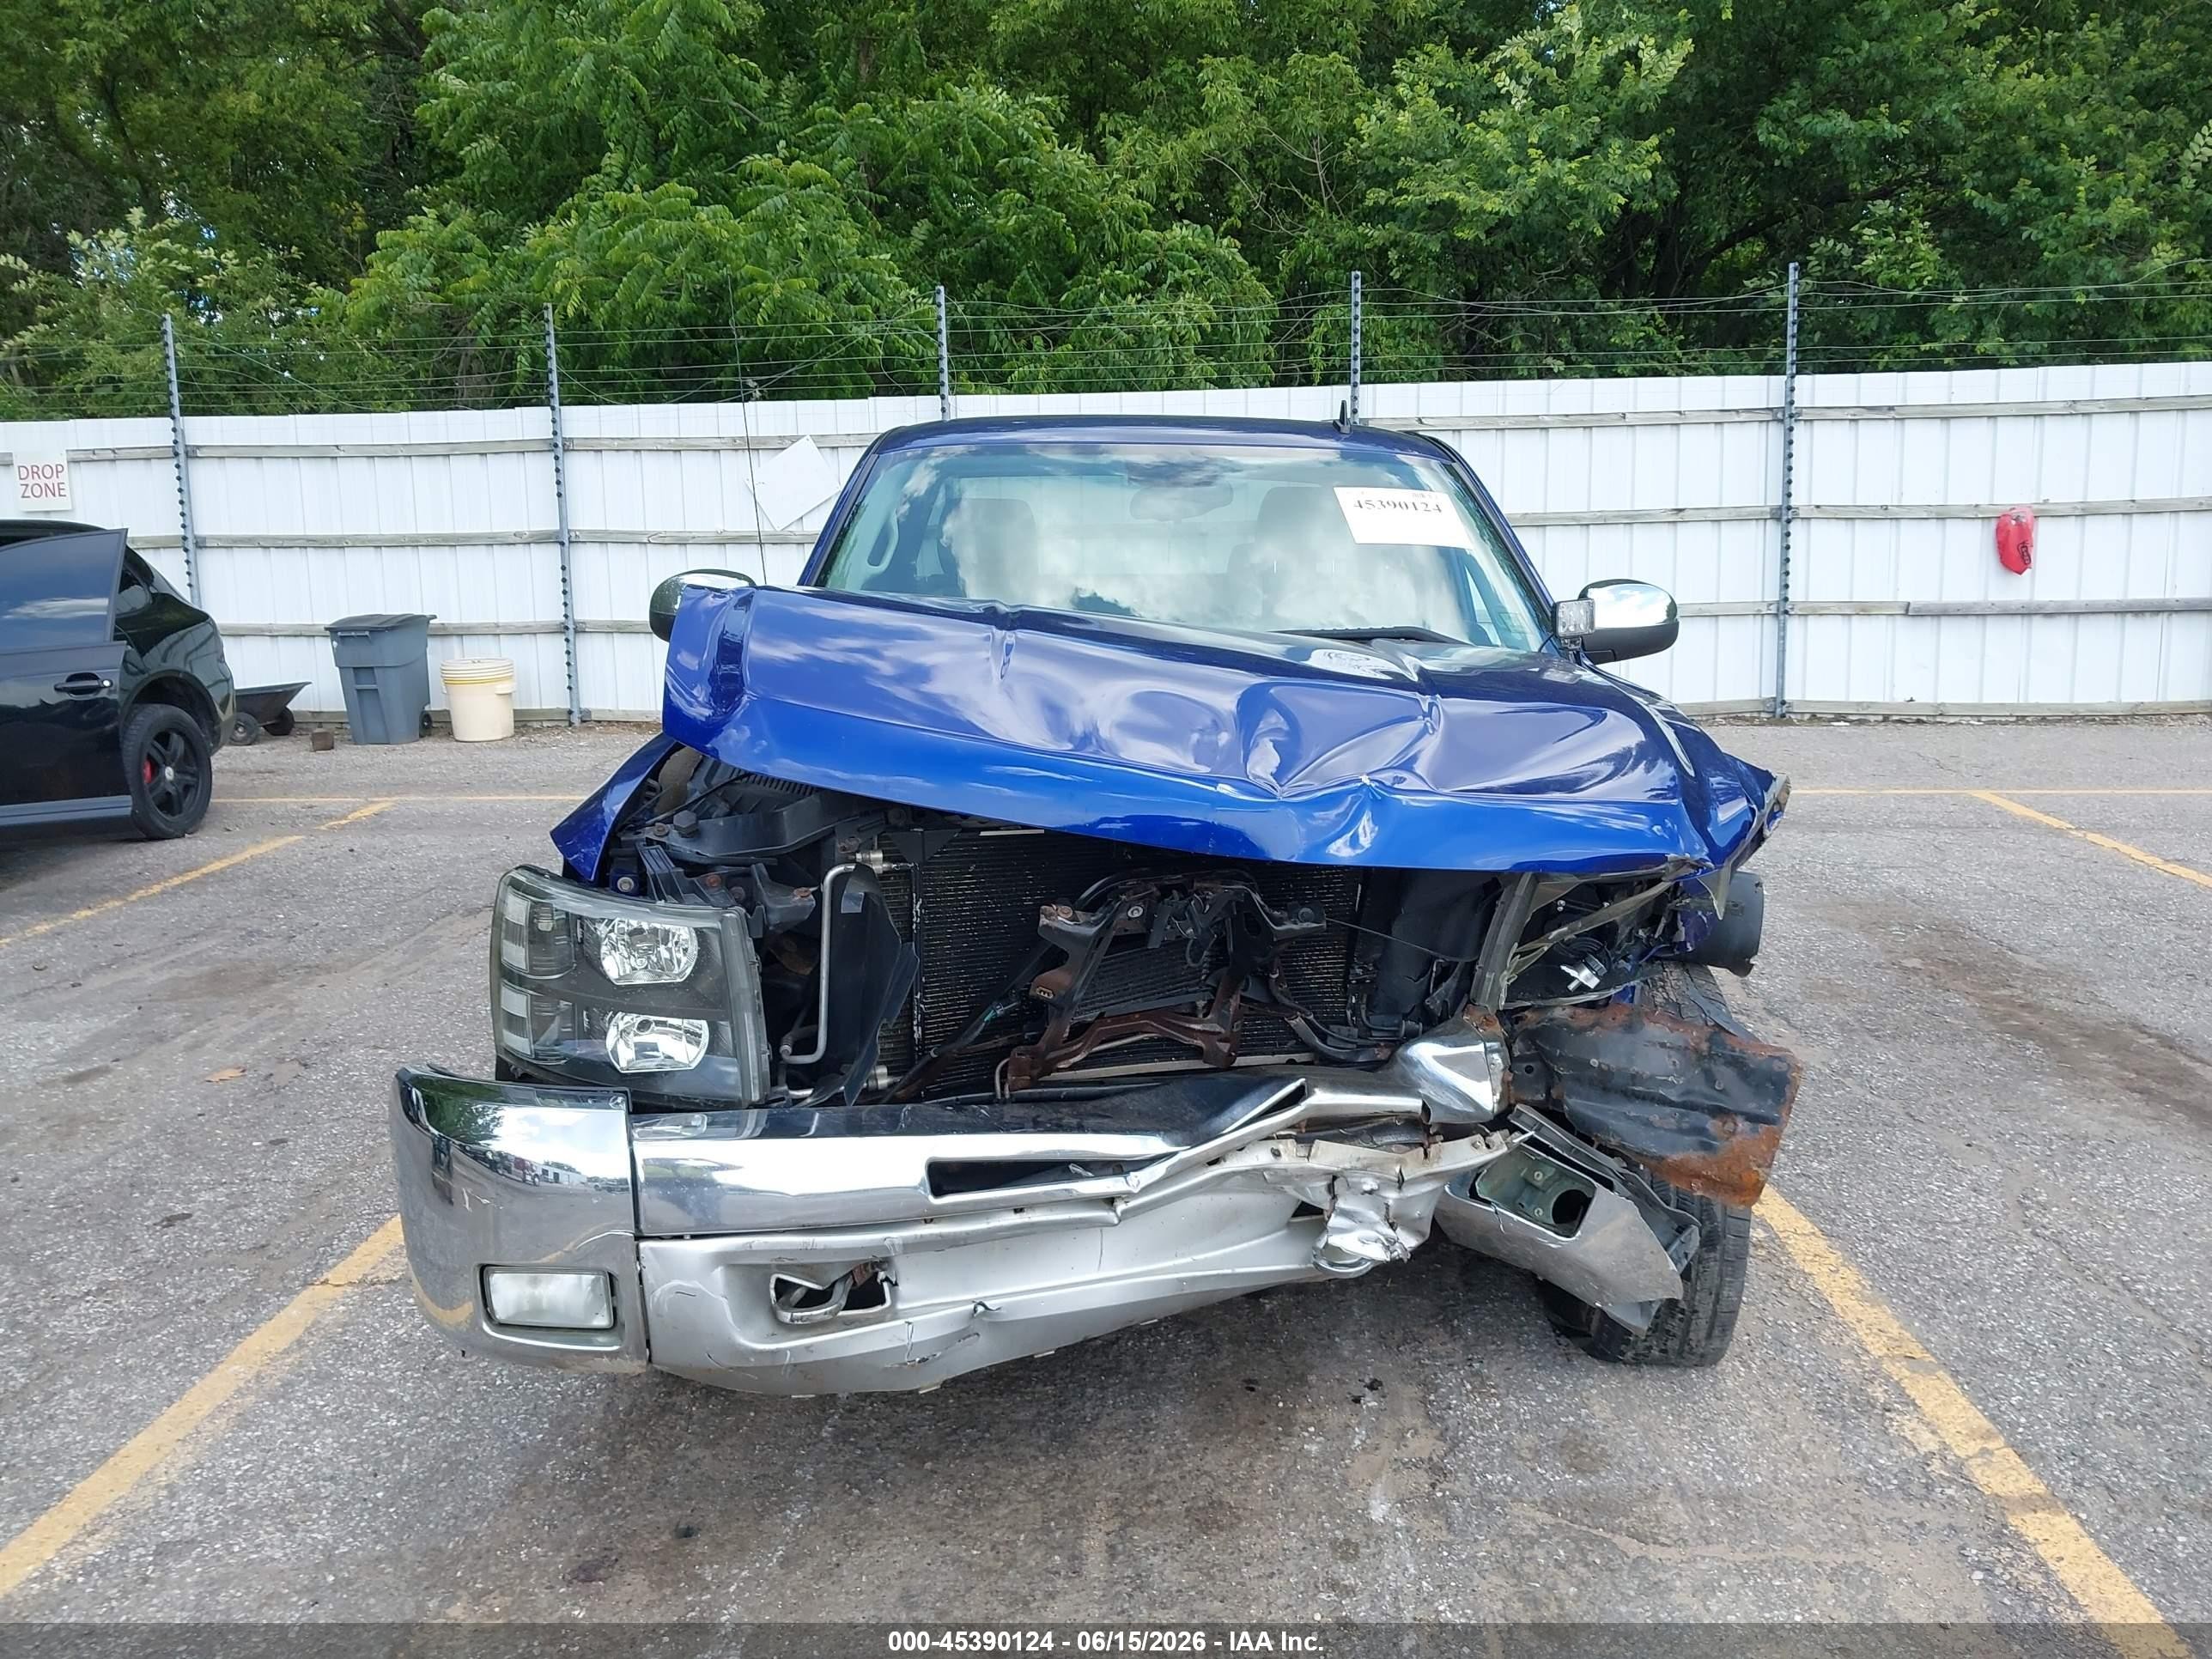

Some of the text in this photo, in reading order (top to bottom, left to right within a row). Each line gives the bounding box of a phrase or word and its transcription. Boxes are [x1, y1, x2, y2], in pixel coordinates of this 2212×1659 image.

[17, 464, 65, 481] DROP
[20, 482, 67, 499] ZONE
[1353, 499, 1443, 514] 45390124
